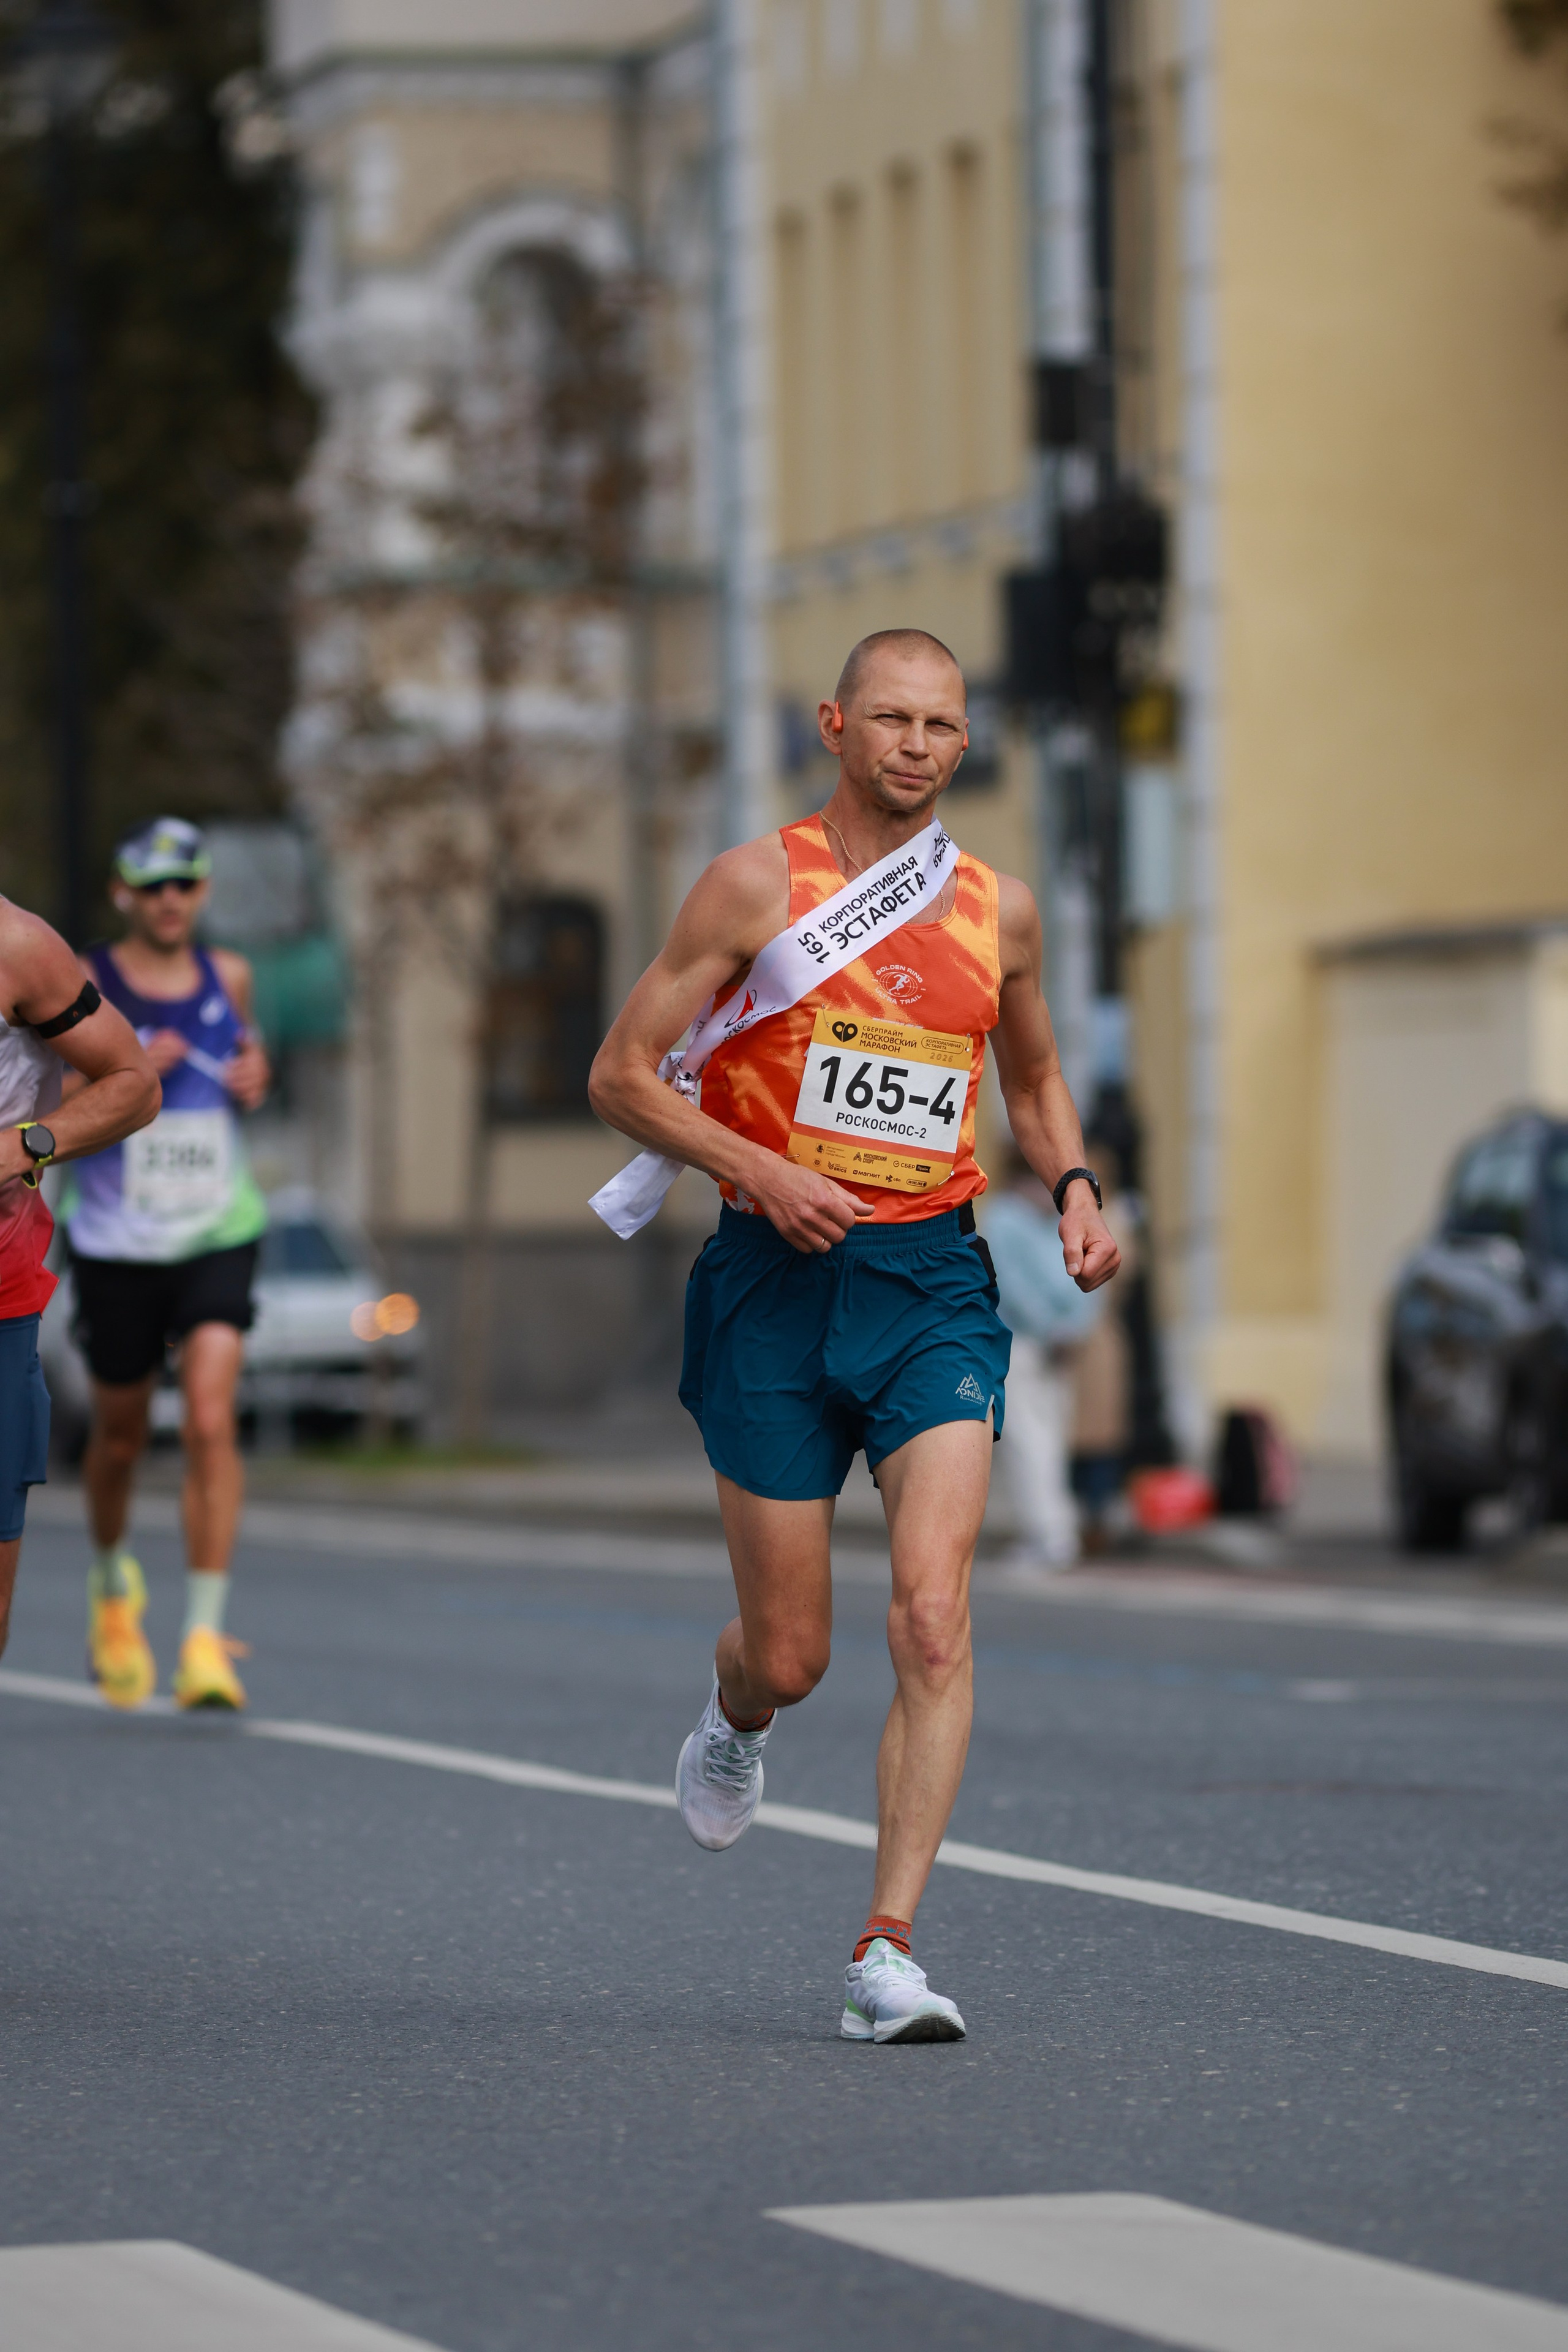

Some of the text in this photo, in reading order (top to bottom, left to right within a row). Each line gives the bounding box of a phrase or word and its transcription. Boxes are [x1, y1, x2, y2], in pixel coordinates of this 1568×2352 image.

[818, 856, 918, 933] КОРПОРАТИВНАЯ
[830, 871, 927, 950] ЭСТАФЕТА
[797, 932, 831, 964] 165
[876, 965, 923, 983] GOLDEN RING
[875, 987, 922, 1005] ULTRA TRAIL
[721, 1006, 777, 1044] ОСКОСМОС
[862, 1025, 903, 1037] СБЕРПРАЙМ
[859, 1039, 900, 1053] МАРАФОН
[861, 1031, 917, 1048] МОСКОВСКИЙ
[925, 1038, 962, 1049] КОРПОРАТИВНАЯ
[820, 1055, 957, 1125] 165-4
[835, 1112, 927, 1139] РОСКОСМОС-2
